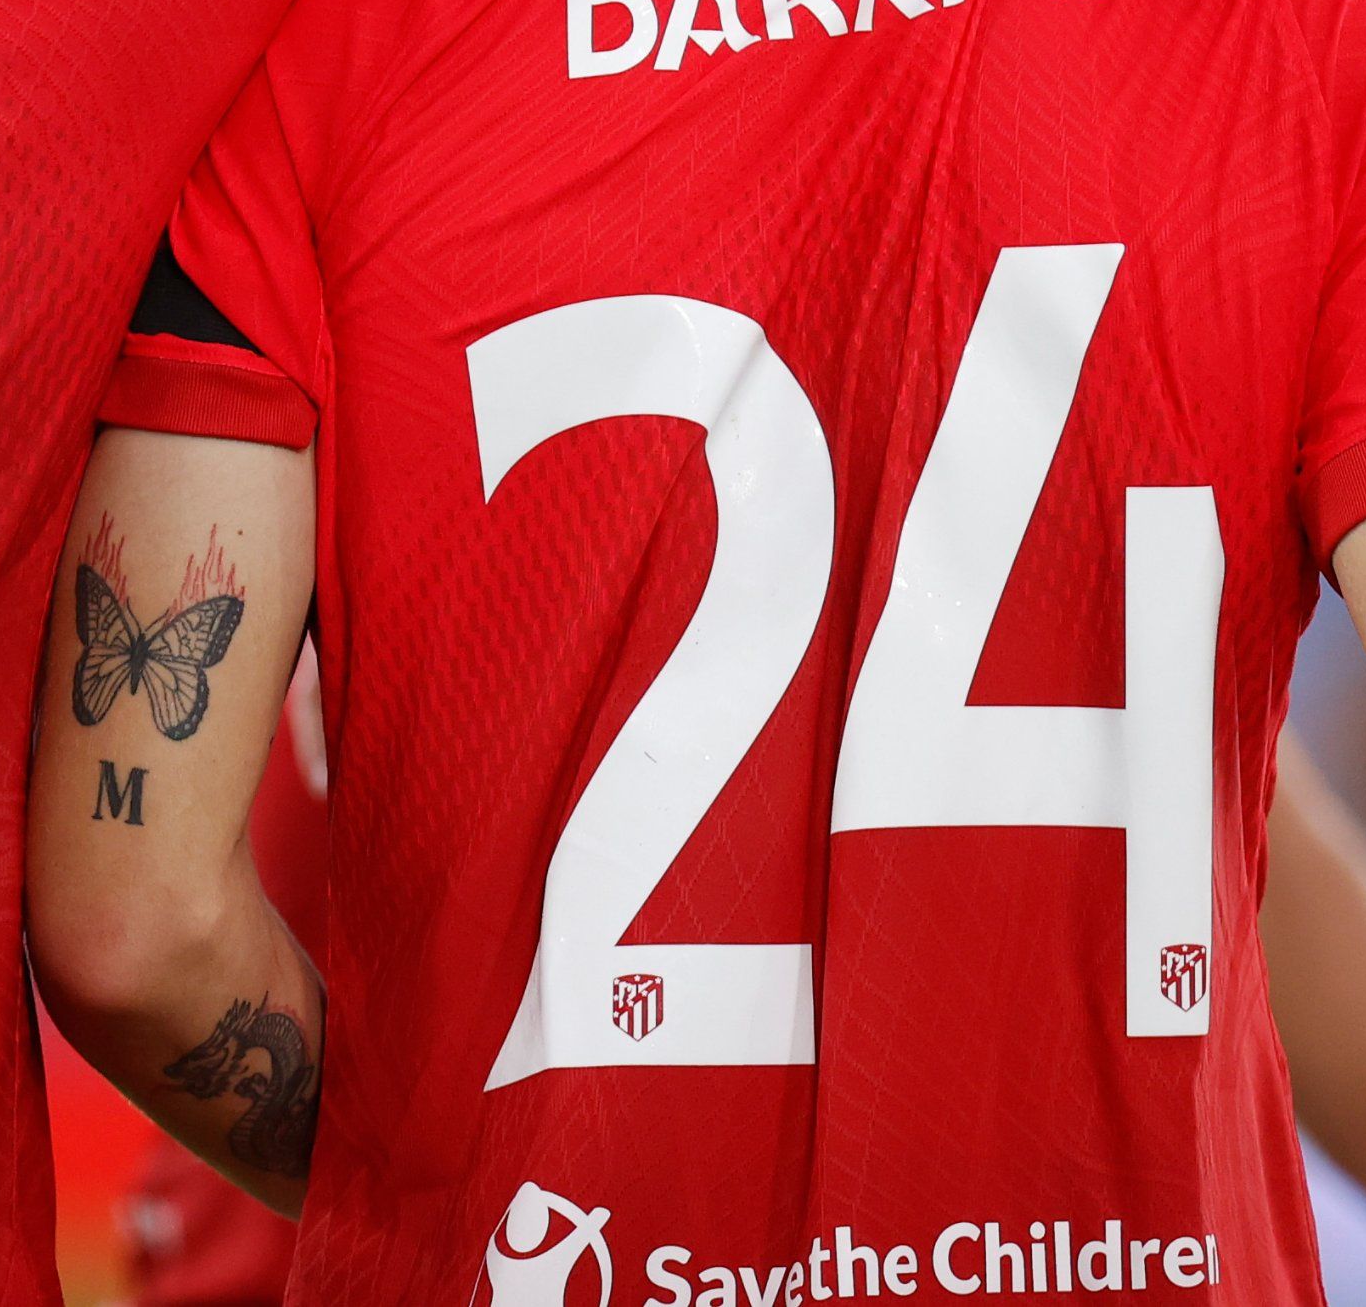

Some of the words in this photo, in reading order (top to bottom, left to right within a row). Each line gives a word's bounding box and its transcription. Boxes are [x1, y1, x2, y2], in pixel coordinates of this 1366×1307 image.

[465, 242, 1226, 1093] 24
[91, 759, 150, 826] M
[643, 1245, 805, 1307] Save
[808, 1226, 919, 1300] the
[932, 1219, 1221, 1295] Children
